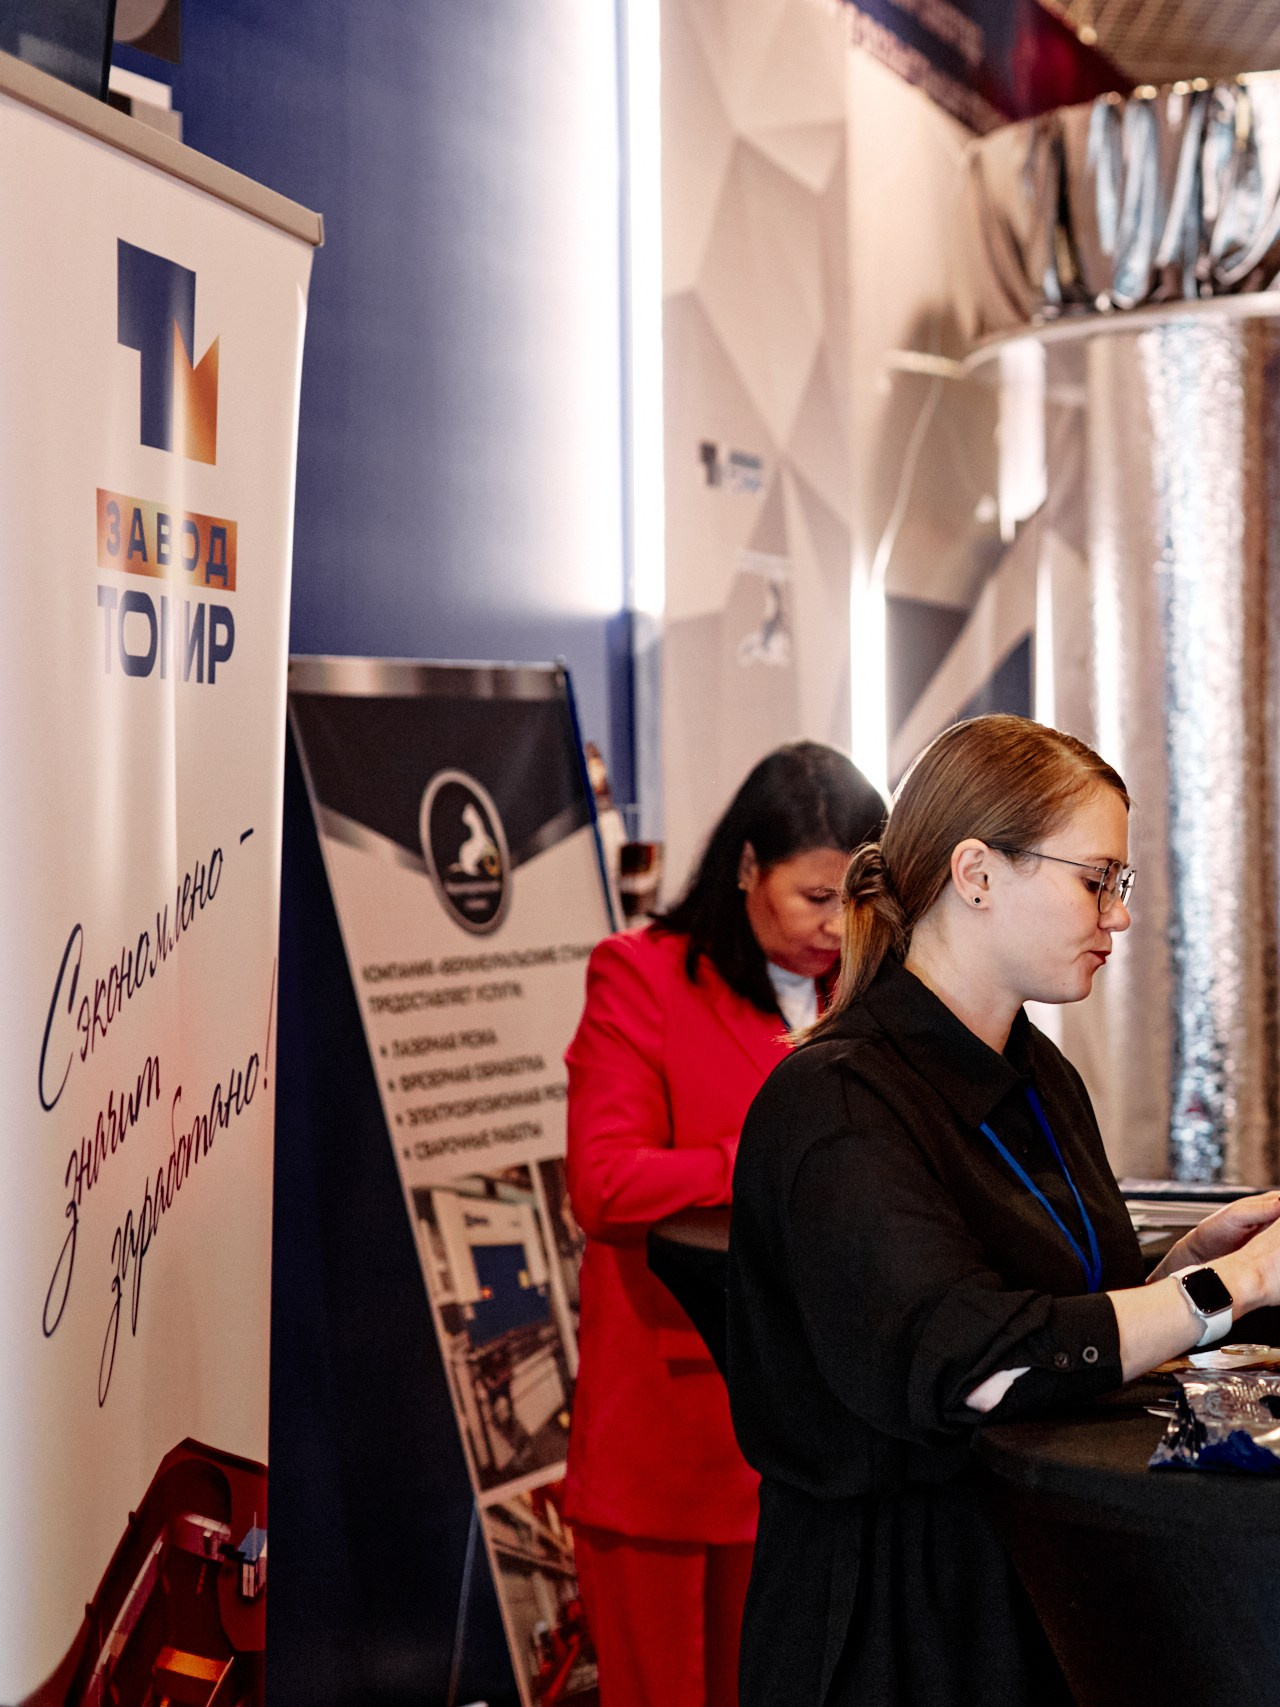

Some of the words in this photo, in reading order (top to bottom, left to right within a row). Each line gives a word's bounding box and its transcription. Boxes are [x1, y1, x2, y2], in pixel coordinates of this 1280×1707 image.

[106, 500, 228, 587] ЗАВОД
[39, 847, 223, 1112] Сэкономлено
[43, 1055, 161, 1339] значит
[97, 956, 277, 1409] заработано!
